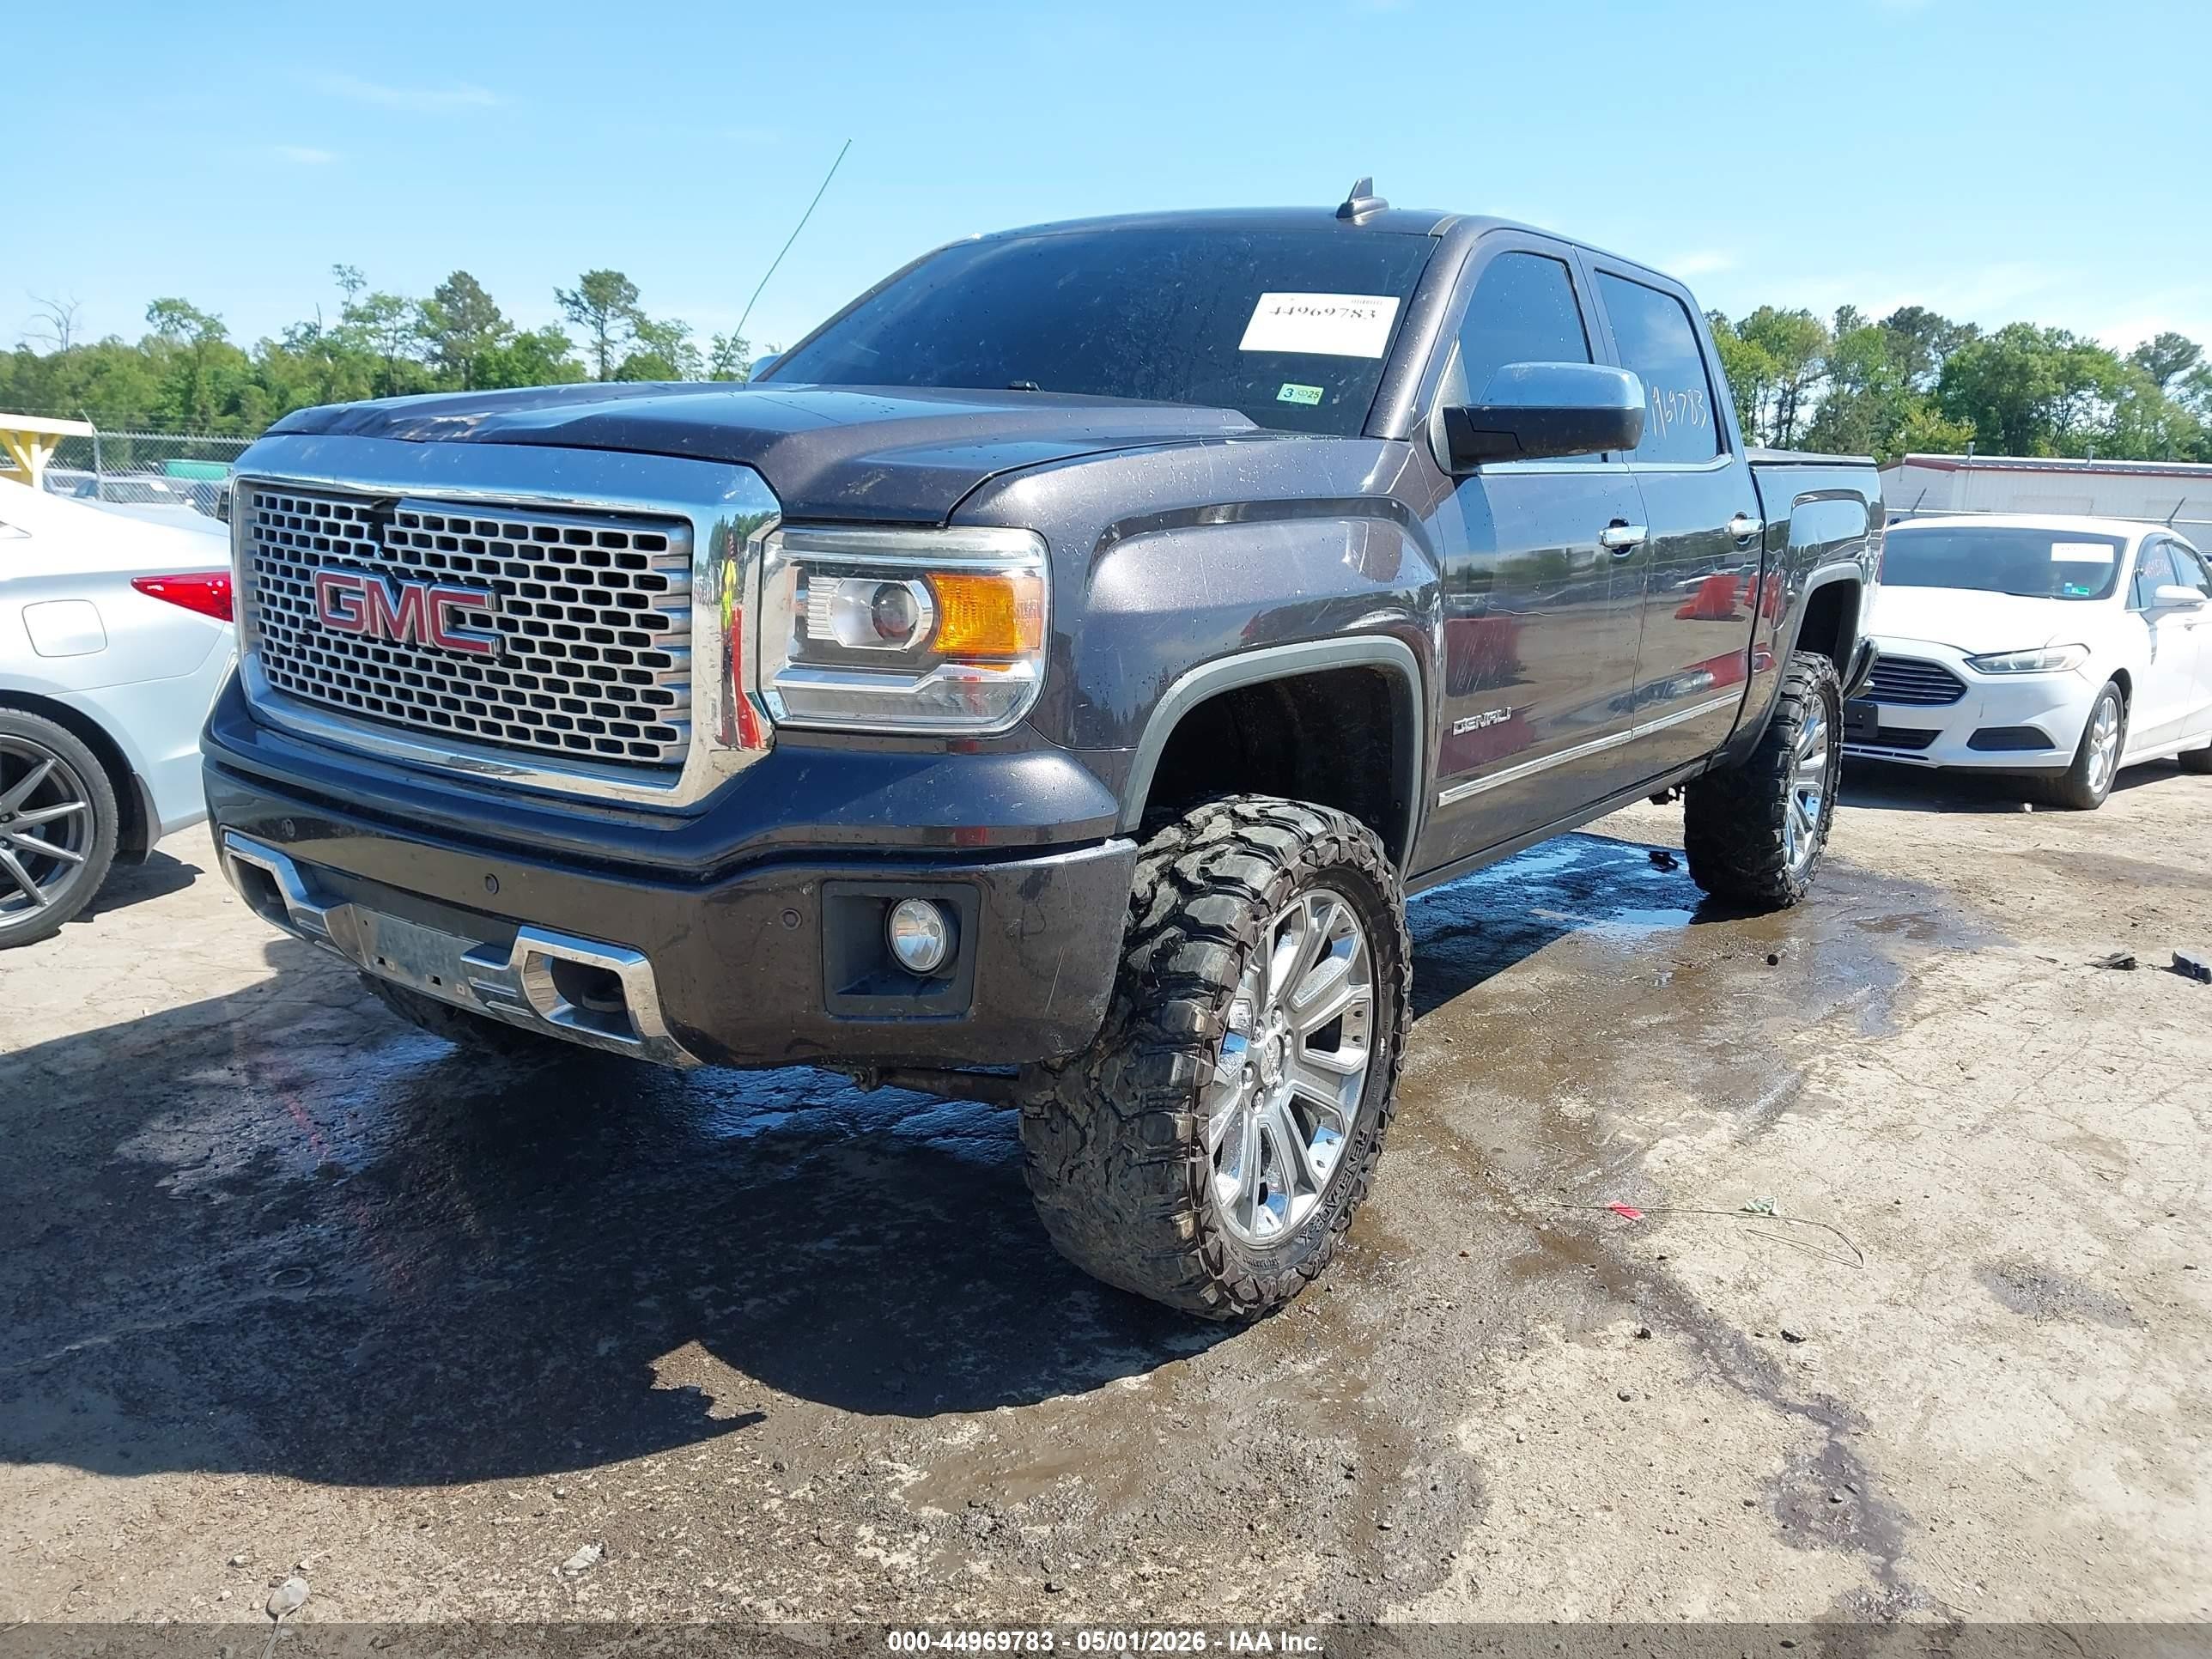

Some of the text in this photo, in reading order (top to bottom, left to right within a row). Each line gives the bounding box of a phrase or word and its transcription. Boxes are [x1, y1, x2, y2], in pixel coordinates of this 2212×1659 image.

[1269, 307, 1376, 319] 44969783
[1284, 388, 1321, 399] 3 25
[315, 565, 501, 659] GMC
[1453, 707, 1511, 736] DENALI
